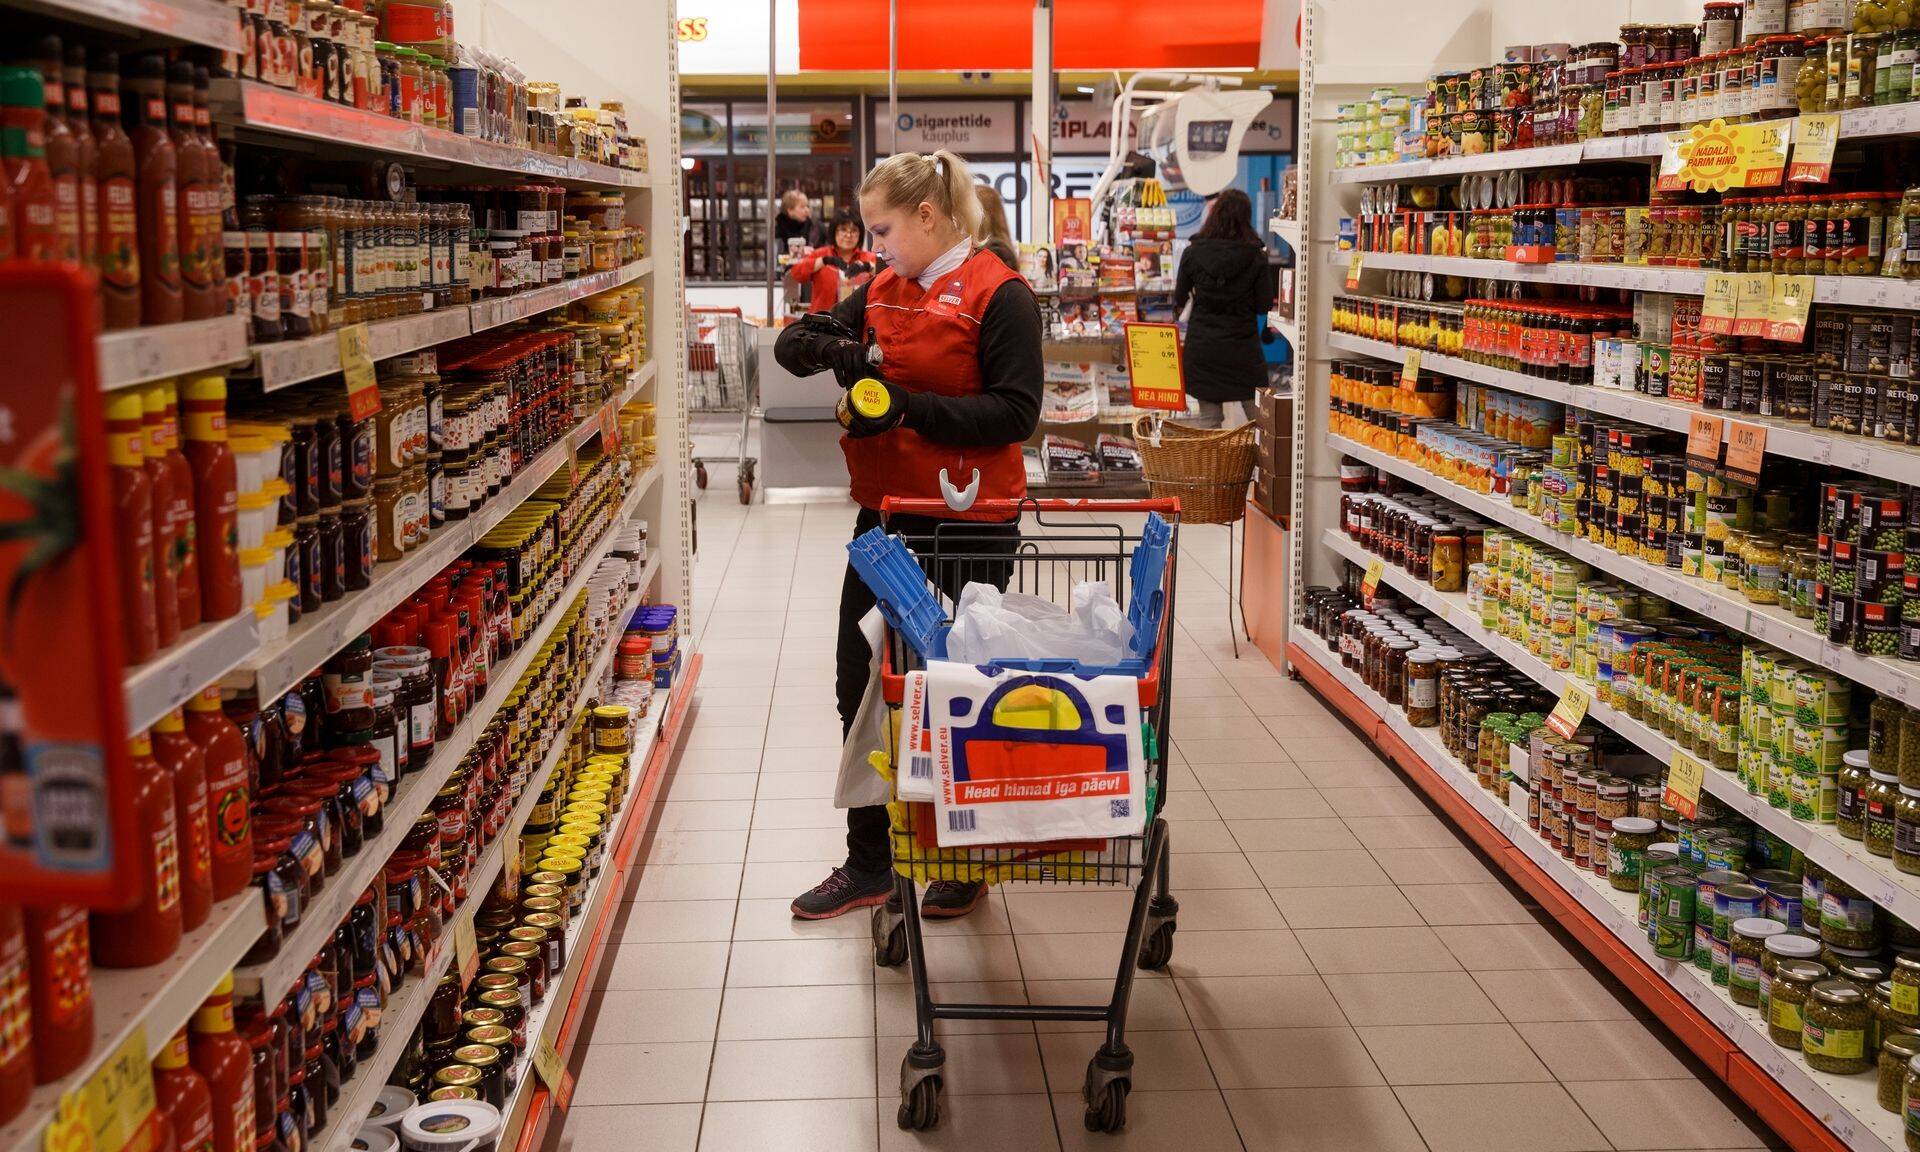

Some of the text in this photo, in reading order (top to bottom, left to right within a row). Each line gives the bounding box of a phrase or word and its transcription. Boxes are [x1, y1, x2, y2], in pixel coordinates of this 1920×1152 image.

[915, 114, 992, 129] sigarettide
[1807, 121, 1825, 137] 2.59
[922, 130, 970, 144] kauplus
[1761, 128, 1778, 144] 1.79
[1686, 155, 1738, 168] PARIM HIND
[1714, 279, 1729, 294] 1.29
[1748, 280, 1761, 295] 1.29
[1783, 283, 1800, 298] 1.29
[863, 389, 880, 397] MEIE
[1138, 390, 1179, 403] HEA HIND
[1698, 420, 1712, 434] 0.89
[909, 674, 924, 751] www.selver.eu
[939, 727, 952, 806] www.selver.eu
[1679, 760, 1693, 776] 1.19
[964, 776, 1120, 799] Head hinnad iga päev!
